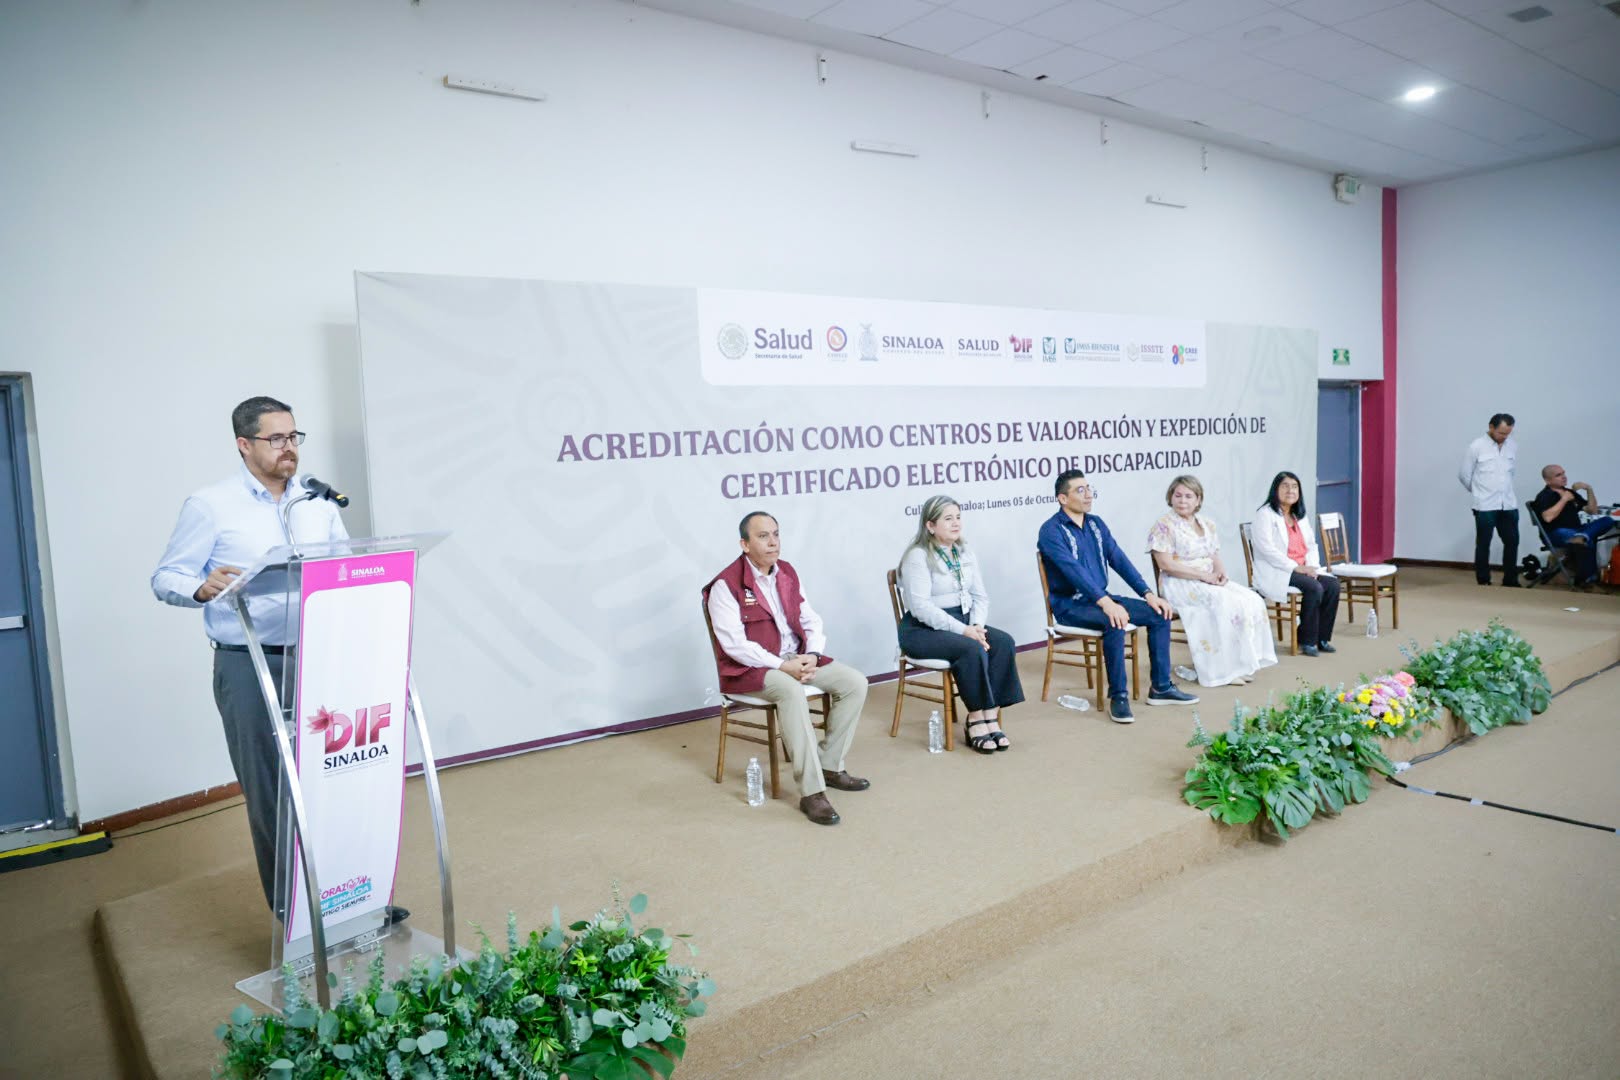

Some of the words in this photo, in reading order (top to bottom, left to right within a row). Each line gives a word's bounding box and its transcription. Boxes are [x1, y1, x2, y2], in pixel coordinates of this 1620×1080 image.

[754, 327, 813, 350] Salud
[882, 335, 944, 350] SINALOA
[958, 338, 1000, 351] SALUD
[1013, 338, 1033, 353] DIF
[1091, 343, 1120, 351] BIENESTAR
[557, 421, 794, 462] ACREDITACIÓN
[801, 425, 884, 450] COMO
[889, 423, 991, 447] CENTROS
[997, 422, 1023, 443] DE
[1028, 414, 1142, 441] VALORACIÓN
[1146, 419, 1156, 438] Y
[1160, 413, 1247, 437] EXPEDICIÓN
[1250, 417, 1266, 433] DE
[720, 465, 900, 499] CERTIFICADO
[906, 453, 1051, 487] ELECTRÓNICO
[1056, 456, 1079, 476] DE
[1084, 449, 1202, 474] DISCAPACIDAD
[959, 500, 985, 512] naloa;
[987, 499, 1012, 509] Lunes
[1013, 498, 1024, 506] 05
[1025, 496, 1035, 505] de
[351, 566, 385, 577] SINALOA
[324, 702, 391, 755] DIF
[323, 744, 389, 770] SINALOA
